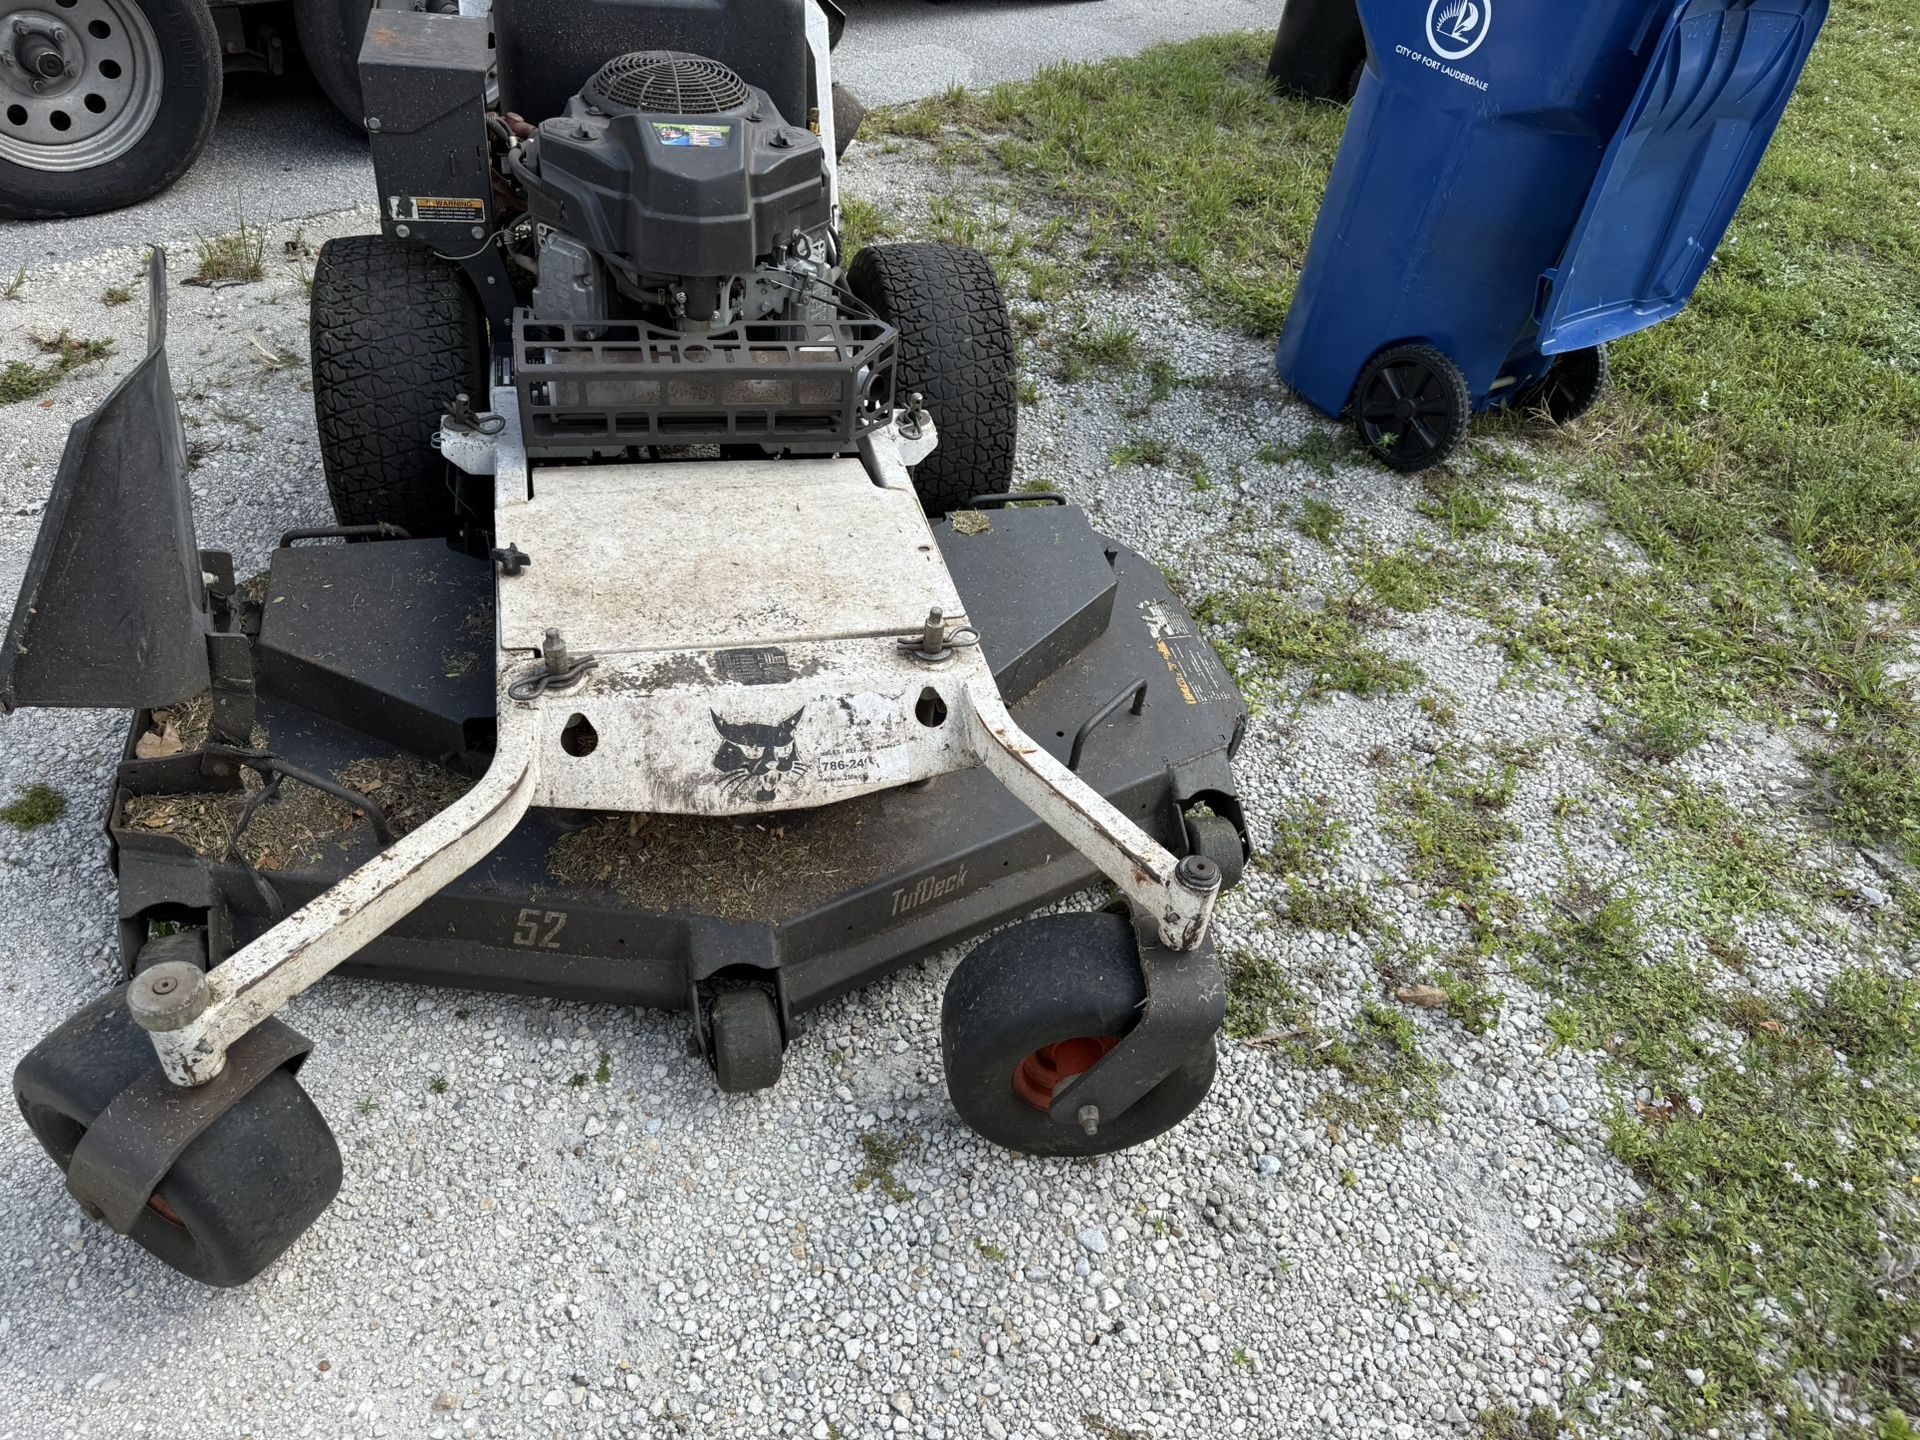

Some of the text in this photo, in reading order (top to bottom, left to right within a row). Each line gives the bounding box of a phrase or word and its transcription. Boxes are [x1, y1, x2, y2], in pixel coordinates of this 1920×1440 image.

[1395, 44, 1489, 91] CITY OF FORT LAUDERDALE
[435, 199, 473, 207] WARNING
[649, 344, 741, 364] HOT
[891, 863, 969, 916] TufDeck
[513, 907, 568, 949] 52
